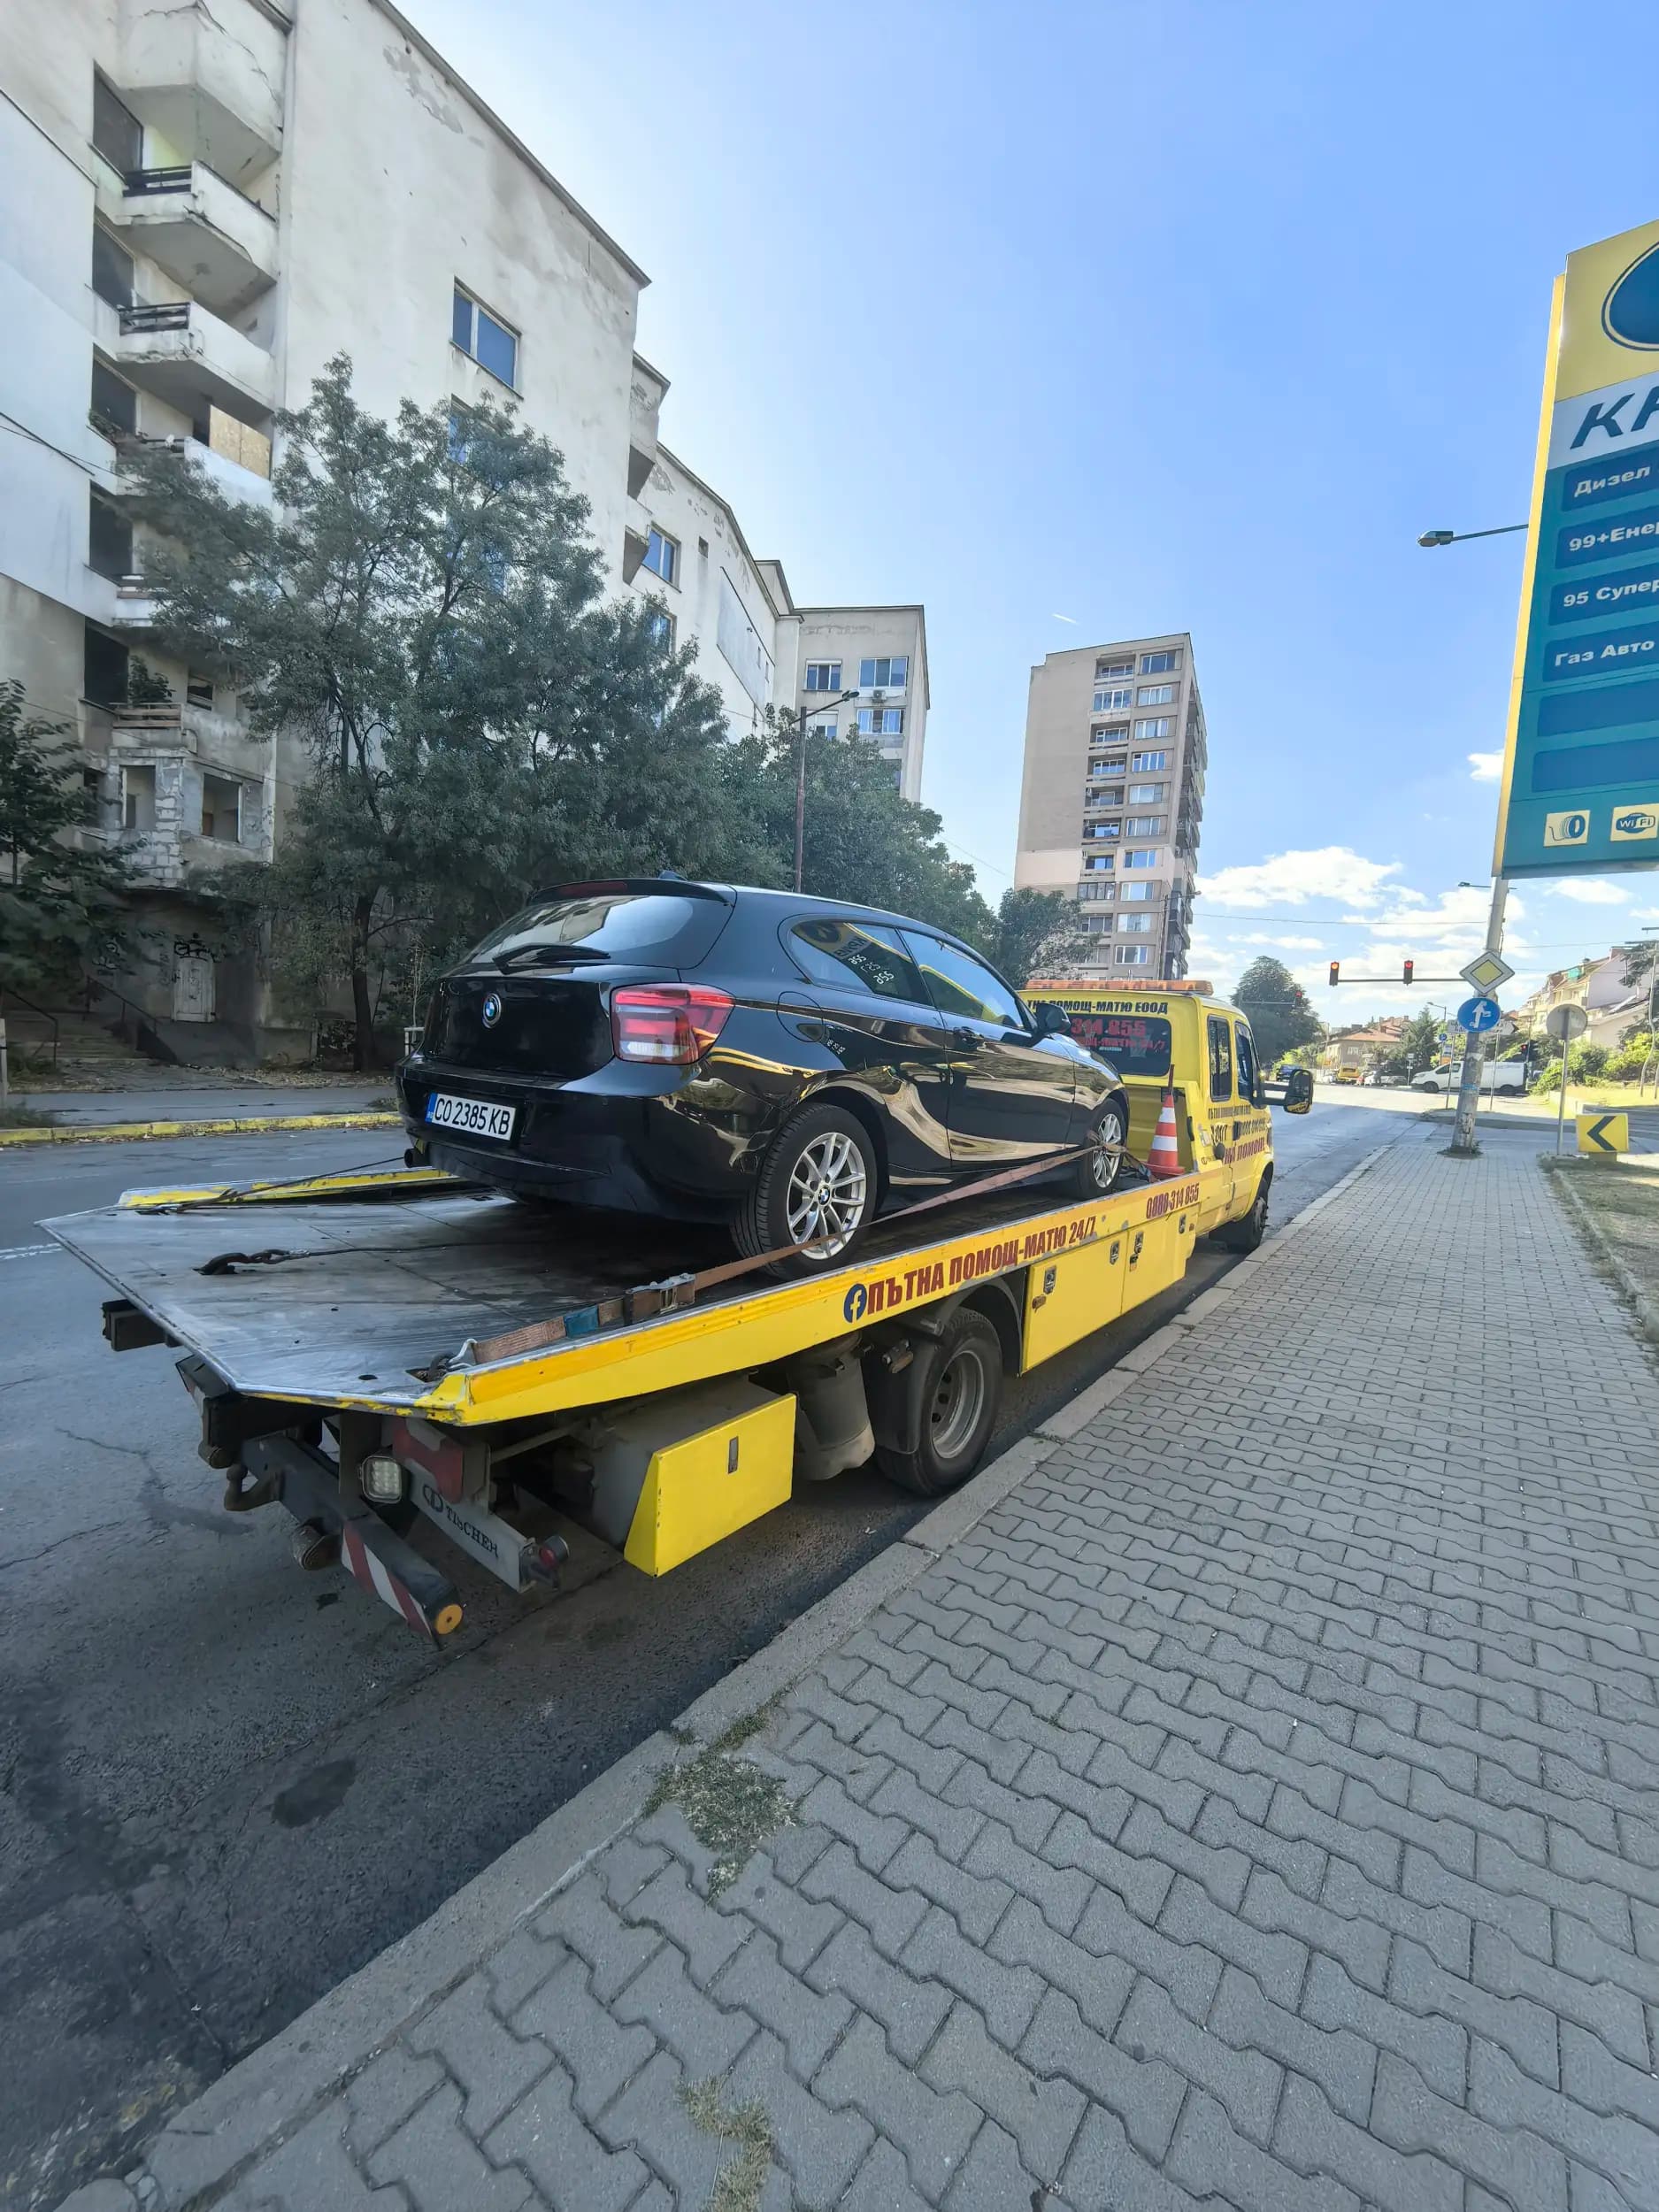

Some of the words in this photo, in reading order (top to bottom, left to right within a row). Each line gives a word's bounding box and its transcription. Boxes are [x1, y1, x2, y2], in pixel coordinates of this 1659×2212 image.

[1574, 466, 1651, 497] Дизел
[1563, 591, 1589, 607] 95
[1555, 651, 1594, 666] Газ
[1601, 641, 1655, 659] Авто
[1135, 1002, 1168, 1015] ЕООД
[1108, 1019, 1147, 1037] 855
[1170, 1187, 1184, 1211] 314
[1185, 1182, 1200, 1205] 855
[867, 1263, 944, 1315] ПЪТНА
[1069, 1216, 1096, 1244] 24/7
